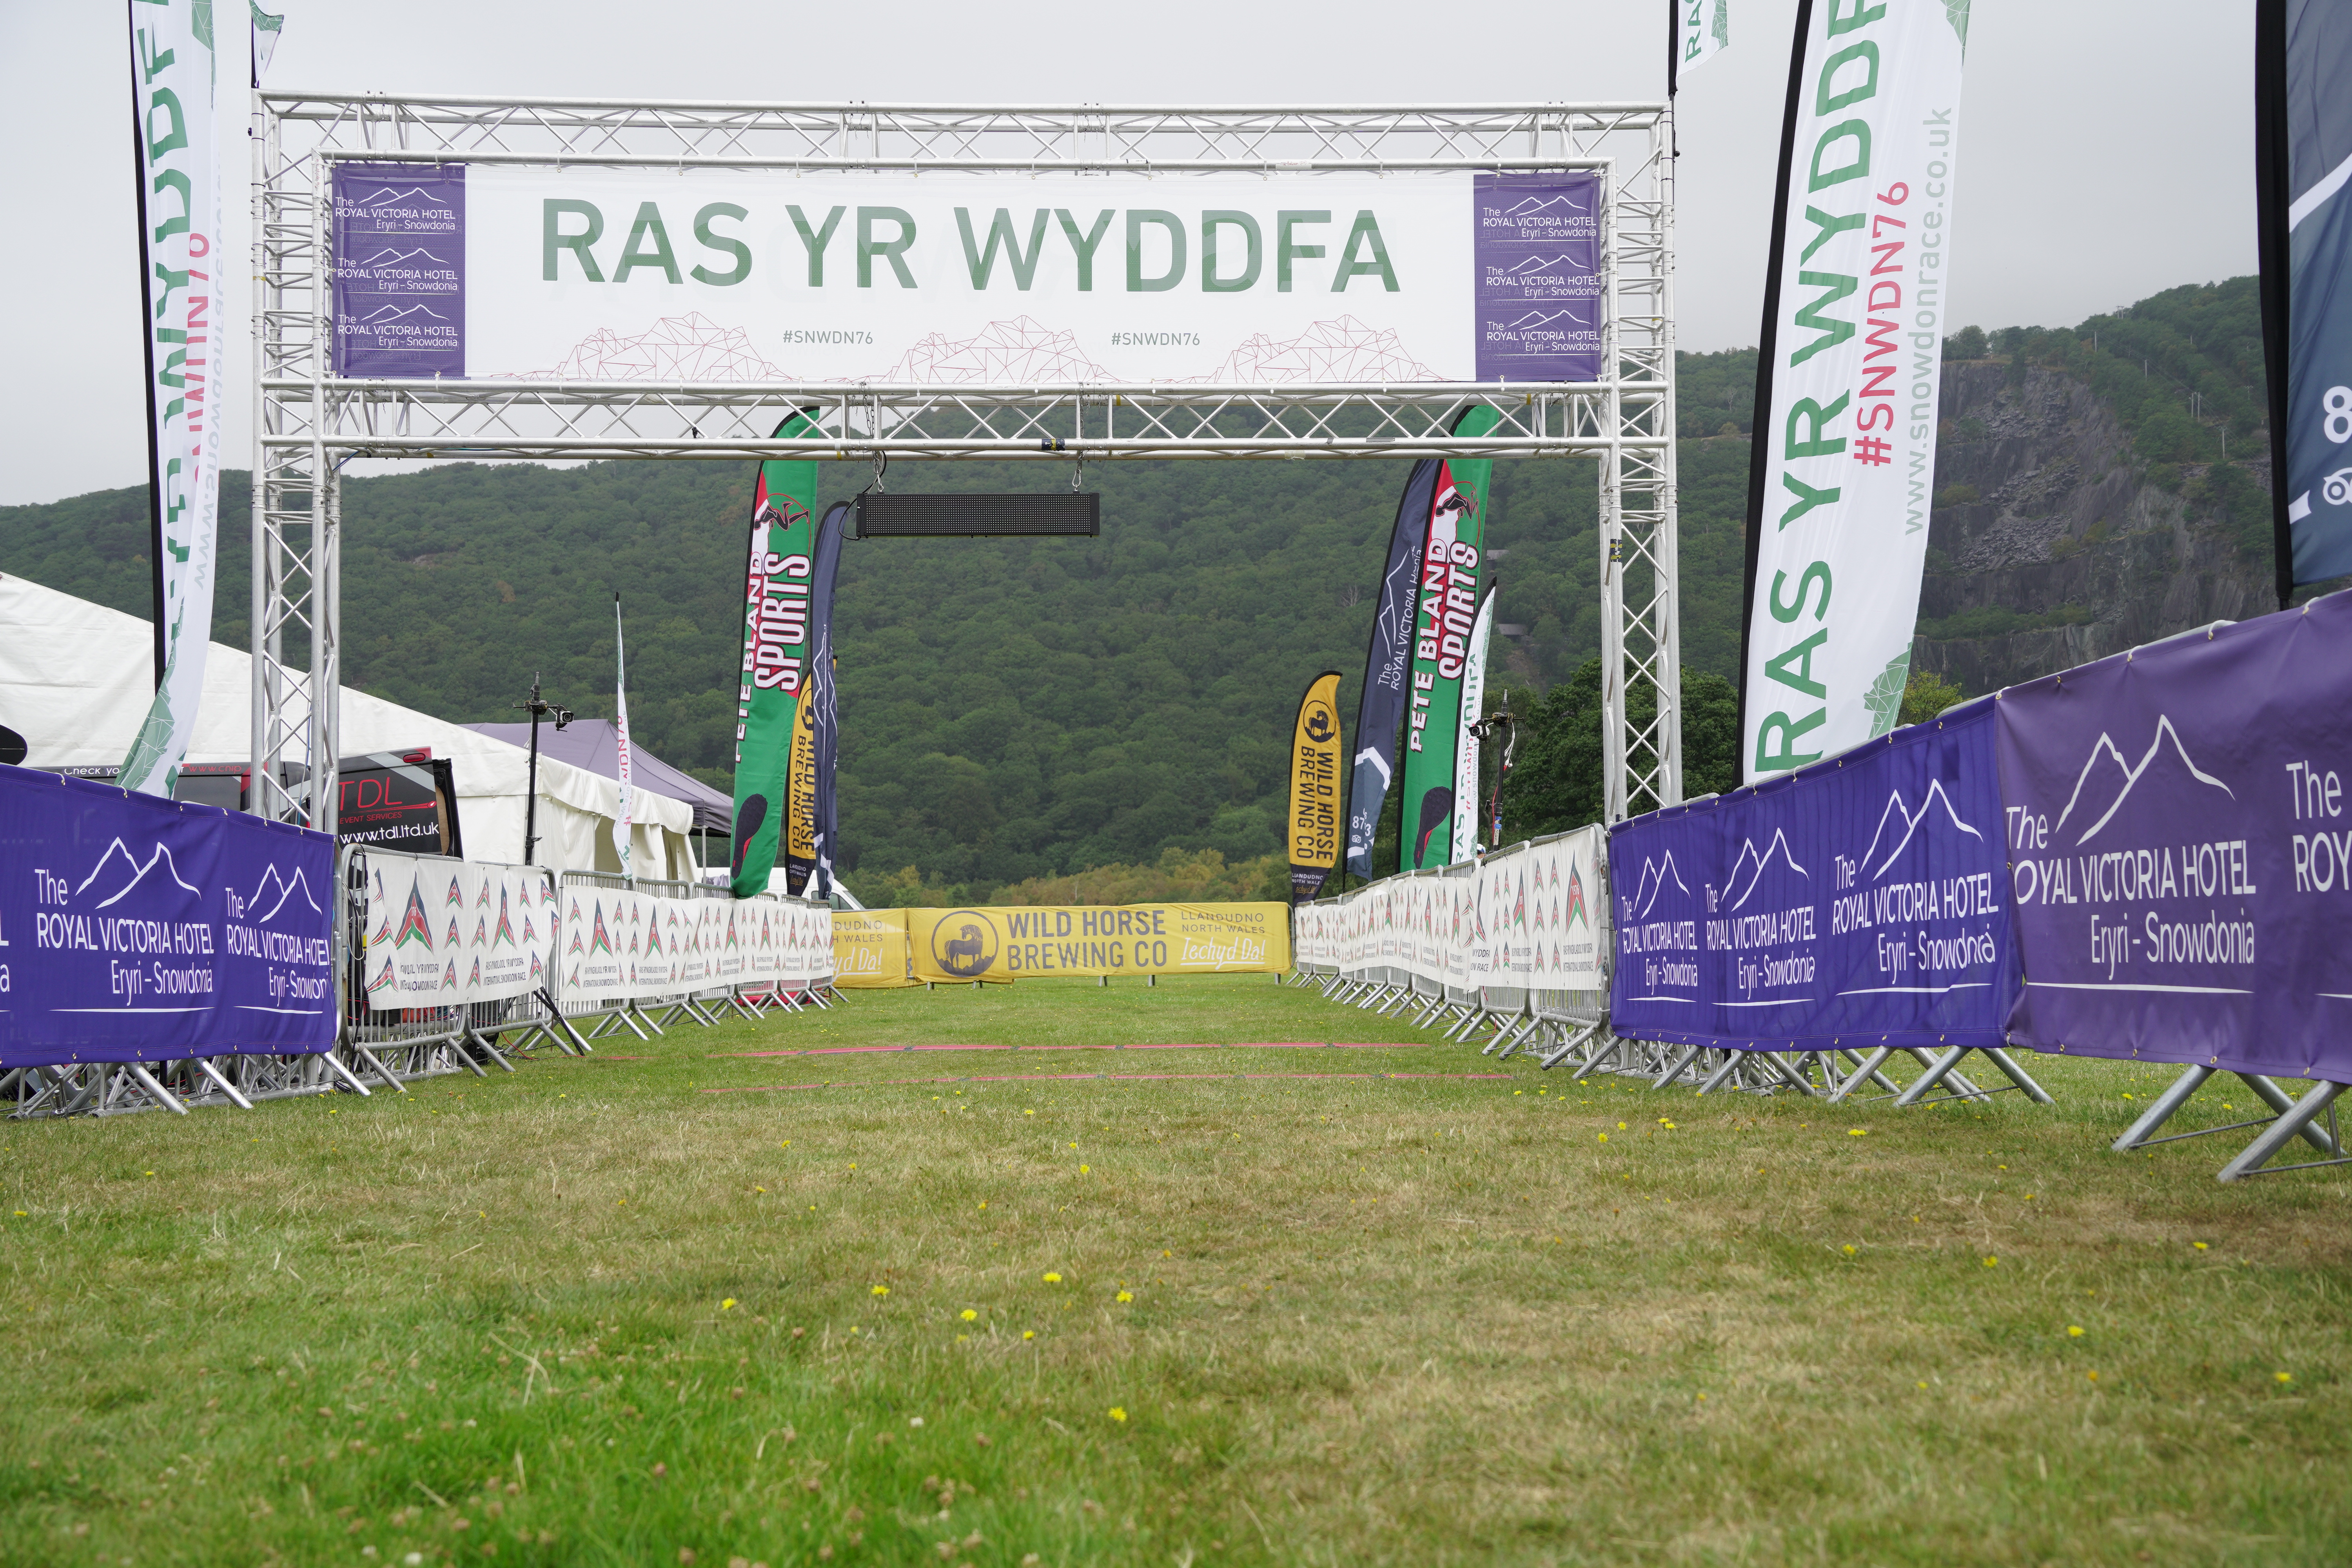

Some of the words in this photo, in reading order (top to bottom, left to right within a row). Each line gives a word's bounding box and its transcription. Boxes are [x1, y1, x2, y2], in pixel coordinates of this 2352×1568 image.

[1685, 0, 1702, 64] RA
[1790, 0, 1886, 368] WYDDF
[132, 0, 191, 430] WYDDF
[335, 197, 354, 206] The
[335, 208, 370, 218] ROYAL
[372, 209, 419, 218] VICTORIA
[422, 210, 456, 219] HOTEL
[1483, 208, 1501, 216] The
[376, 220, 396, 232] Eryri
[405, 220, 456, 230] Snowdonia
[1483, 218, 1515, 227] ROYAL
[1517, 217, 1561, 227] VICTORIA
[1565, 217, 1597, 226] HOTEL
[1522, 228, 1541, 240] Eryri
[1548, 227, 1596, 237] Snowdonia
[543, 199, 752, 287] RAS
[785, 205, 918, 289] YR
[954, 207, 1401, 292] WYDDFA
[338, 258, 356, 267] The
[338, 269, 372, 278] ROYAL
[374, 269, 421, 279] VICTORIA
[424, 270, 458, 280] HOTEL
[1486, 267, 1504, 276] The
[379, 280, 398, 292] Eryri
[407, 281, 458, 290] Snowdonia
[1486, 277, 1519, 286] ROYAL
[1519, 276, 1565, 285] VICTORIA
[1568, 276, 1600, 285] HOTEL
[1525, 287, 1543, 299] Eryri
[1551, 287, 1599, 296] Snowdonia
[338, 314, 356, 324] The
[338, 325, 372, 335] ROYAL
[374, 326, 421, 335] VICTORIA
[424, 326, 458, 336] HOTEL
[1487, 321, 1504, 330] The
[1853, 182, 1909, 467] #SNWDN76
[1905, 107, 1952, 536] www.snowdonrace.co.uk
[379, 336, 398, 348] Eryri
[407, 336, 458, 347] Snowdonia
[783, 330, 873, 345] #SNWDN76
[1111, 332, 1201, 347] #SNWDN76
[1487, 332, 1519, 341] ROYAL
[1520, 331, 1565, 340] VICTORIA
[1568, 331, 1600, 340] HOTEL
[1525, 342, 1544, 354] Eryri
[1552, 341, 1600, 351] Snowdonia
[1779, 388, 1850, 533] YR
[743, 552, 764, 673] BLAND
[1417, 539, 1449, 662] BLAND
[1438, 540, 1479, 680] SPORTS
[754, 552, 811, 691] SPORTS
[1397, 588, 1416, 645] VICTORIA
[1377, 663, 1392, 685] The
[1391, 649, 1406, 690] ROYAL
[1754, 561, 1832, 772] RAS
[1410, 670, 1434, 753] PETE
[107, 767, 120, 776] yo
[793, 735, 806, 819] BREWING
[1298, 746, 1315, 828] BREWING
[1317, 751, 1334, 796] WILD
[338, 777, 403, 811] TDL
[2286, 760, 2342, 820] The
[339, 815, 364, 824] EVENT
[366, 811, 403, 821] SERVICES
[339, 822, 439, 844] www.tdl.ltd.uk
[1316, 804, 1334, 861] HORSE
[2006, 805, 2048, 850] The
[793, 826, 800, 849] CO
[1297, 836, 1314, 858] CO
[1455, 813, 1465, 864] RAS
[1835, 854, 1855, 891] The
[2014, 858, 2078, 906] OYAL
[2080, 846, 2178, 903] VICTORIA
[2183, 840, 2257, 898] HOTEL
[2293, 829, 2352, 892] ROY
[34, 869, 68, 906] The
[225, 887, 244, 919] The
[1571, 884, 1580, 896] 1976
[1706, 883, 1718, 913] The
[1181, 911, 1265, 923] LLANDUDNO
[1622, 895, 1632, 922] The
[1833, 897, 1872, 935] ROYAL
[1872, 881, 1941, 925] VICTORIA
[1943, 872, 1999, 920] HOTEL
[36, 912, 98, 951] ROYAL
[98, 916, 171, 955] VICTORIA
[174, 922, 215, 955] HOTEL
[834, 920, 883, 931] DUDNO
[845, 934, 883, 943] WALES
[1007, 911, 1072, 938] WILD
[1083, 910, 1166, 936] HORSE
[1182, 924, 1222, 933] NORTH
[1227, 925, 1265, 934] WALES
[1622, 926, 1642, 954] ROYAL
[1642, 922, 1672, 952] VICTORIA
[1674, 921, 1698, 950] HOTEL
[1707, 918, 1732, 951] ROYAL
[1733, 911, 1778, 950] VICTORIA
[1780, 906, 1817, 942] HOTEL
[227, 924, 262, 958] ROYAL
[261, 930, 303, 964] VICTORIA
[857, 948, 883, 971] Da!
[1007, 941, 1124, 971] BREWING
[1135, 940, 1167, 967] CO
[1241, 938, 1266, 961] Da!
[1878, 933, 1907, 985] Eryri
[2091, 912, 2129, 980] Eryri
[2146, 908, 2254, 965] Snowdonia
[111, 959, 142, 1006] Eryri
[154, 960, 212, 995] Snowdonia
[518, 972, 526, 981] RACE
[1477, 963, 1488, 972] RACE
[1646, 957, 1658, 995] Eryri
[1662, 956, 1698, 987] Snowdonia
[1739, 957, 1758, 1001] Eryri
[1764, 948, 1815, 988] Snowdonia
[269, 967, 285, 1007] Eryri
[290, 970, 328, 999] Snowdoni
